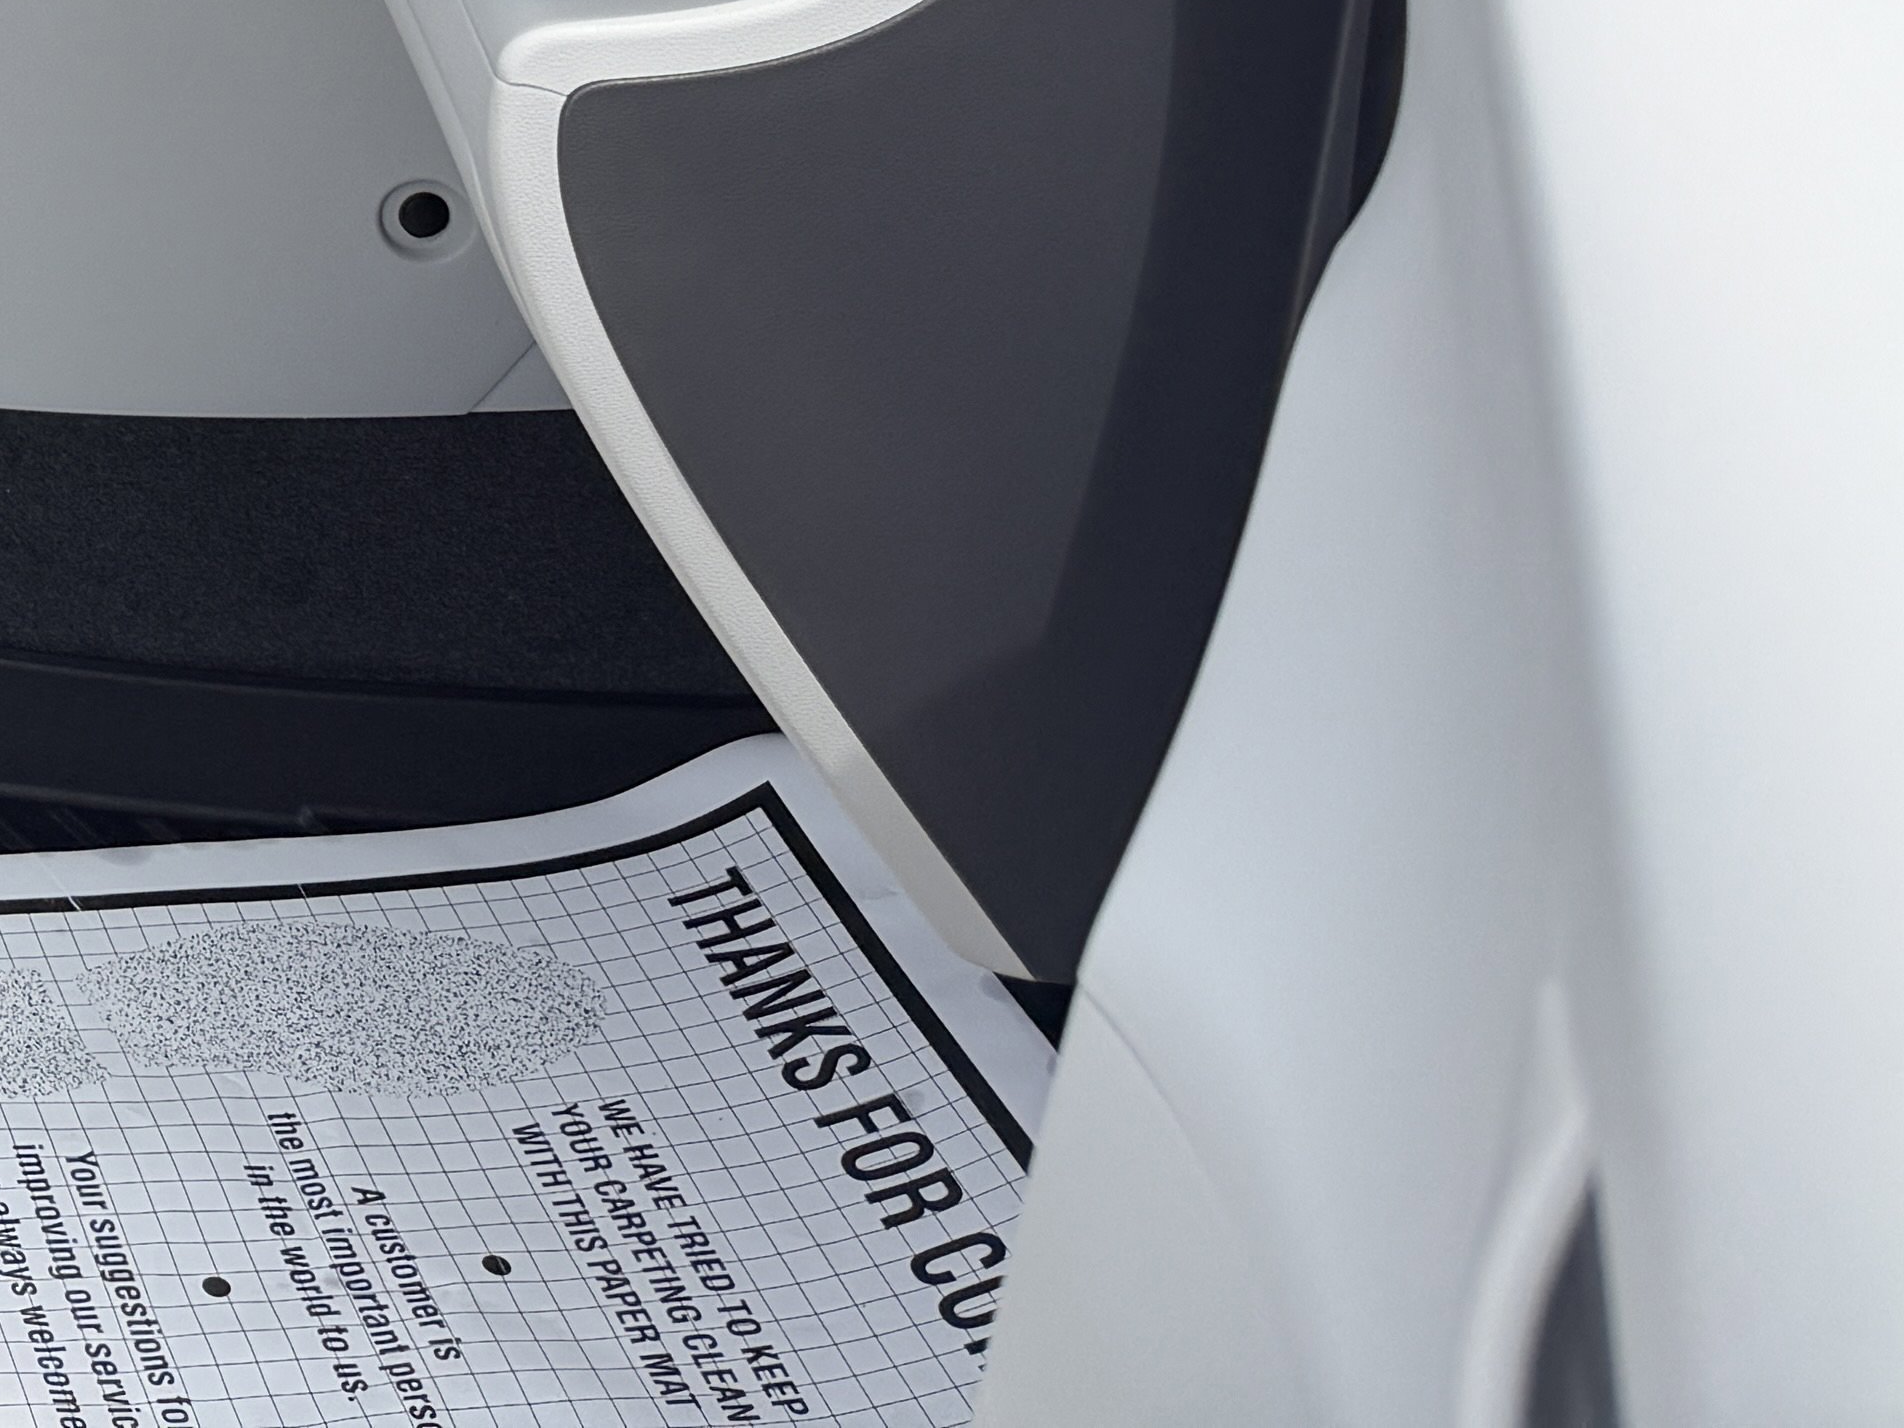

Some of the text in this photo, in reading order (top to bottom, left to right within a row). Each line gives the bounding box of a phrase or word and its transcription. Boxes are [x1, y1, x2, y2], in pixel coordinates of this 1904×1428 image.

[268, 1113, 304, 1149] the
[290, 1159, 343, 1220] most
[322, 1228, 409, 1356] important
[598, 1099, 808, 1415] WE HAVE TRIED TO KEEP
[668, 866, 1007, 1371] THANKS FOR CO
[13, 1145, 140, 1428] improving our servic
[20, 1306, 87, 1428] welcome
[65, 1151, 192, 1428] Your suggestions fo
[244, 1165, 368, 1401] in the world to us.
[352, 1187, 462, 1361] A customer is
[512, 1123, 700, 1409] WITH THIS PAPER MAT
[552, 1104, 760, 1422] YOUR CARPETING CLEAN
